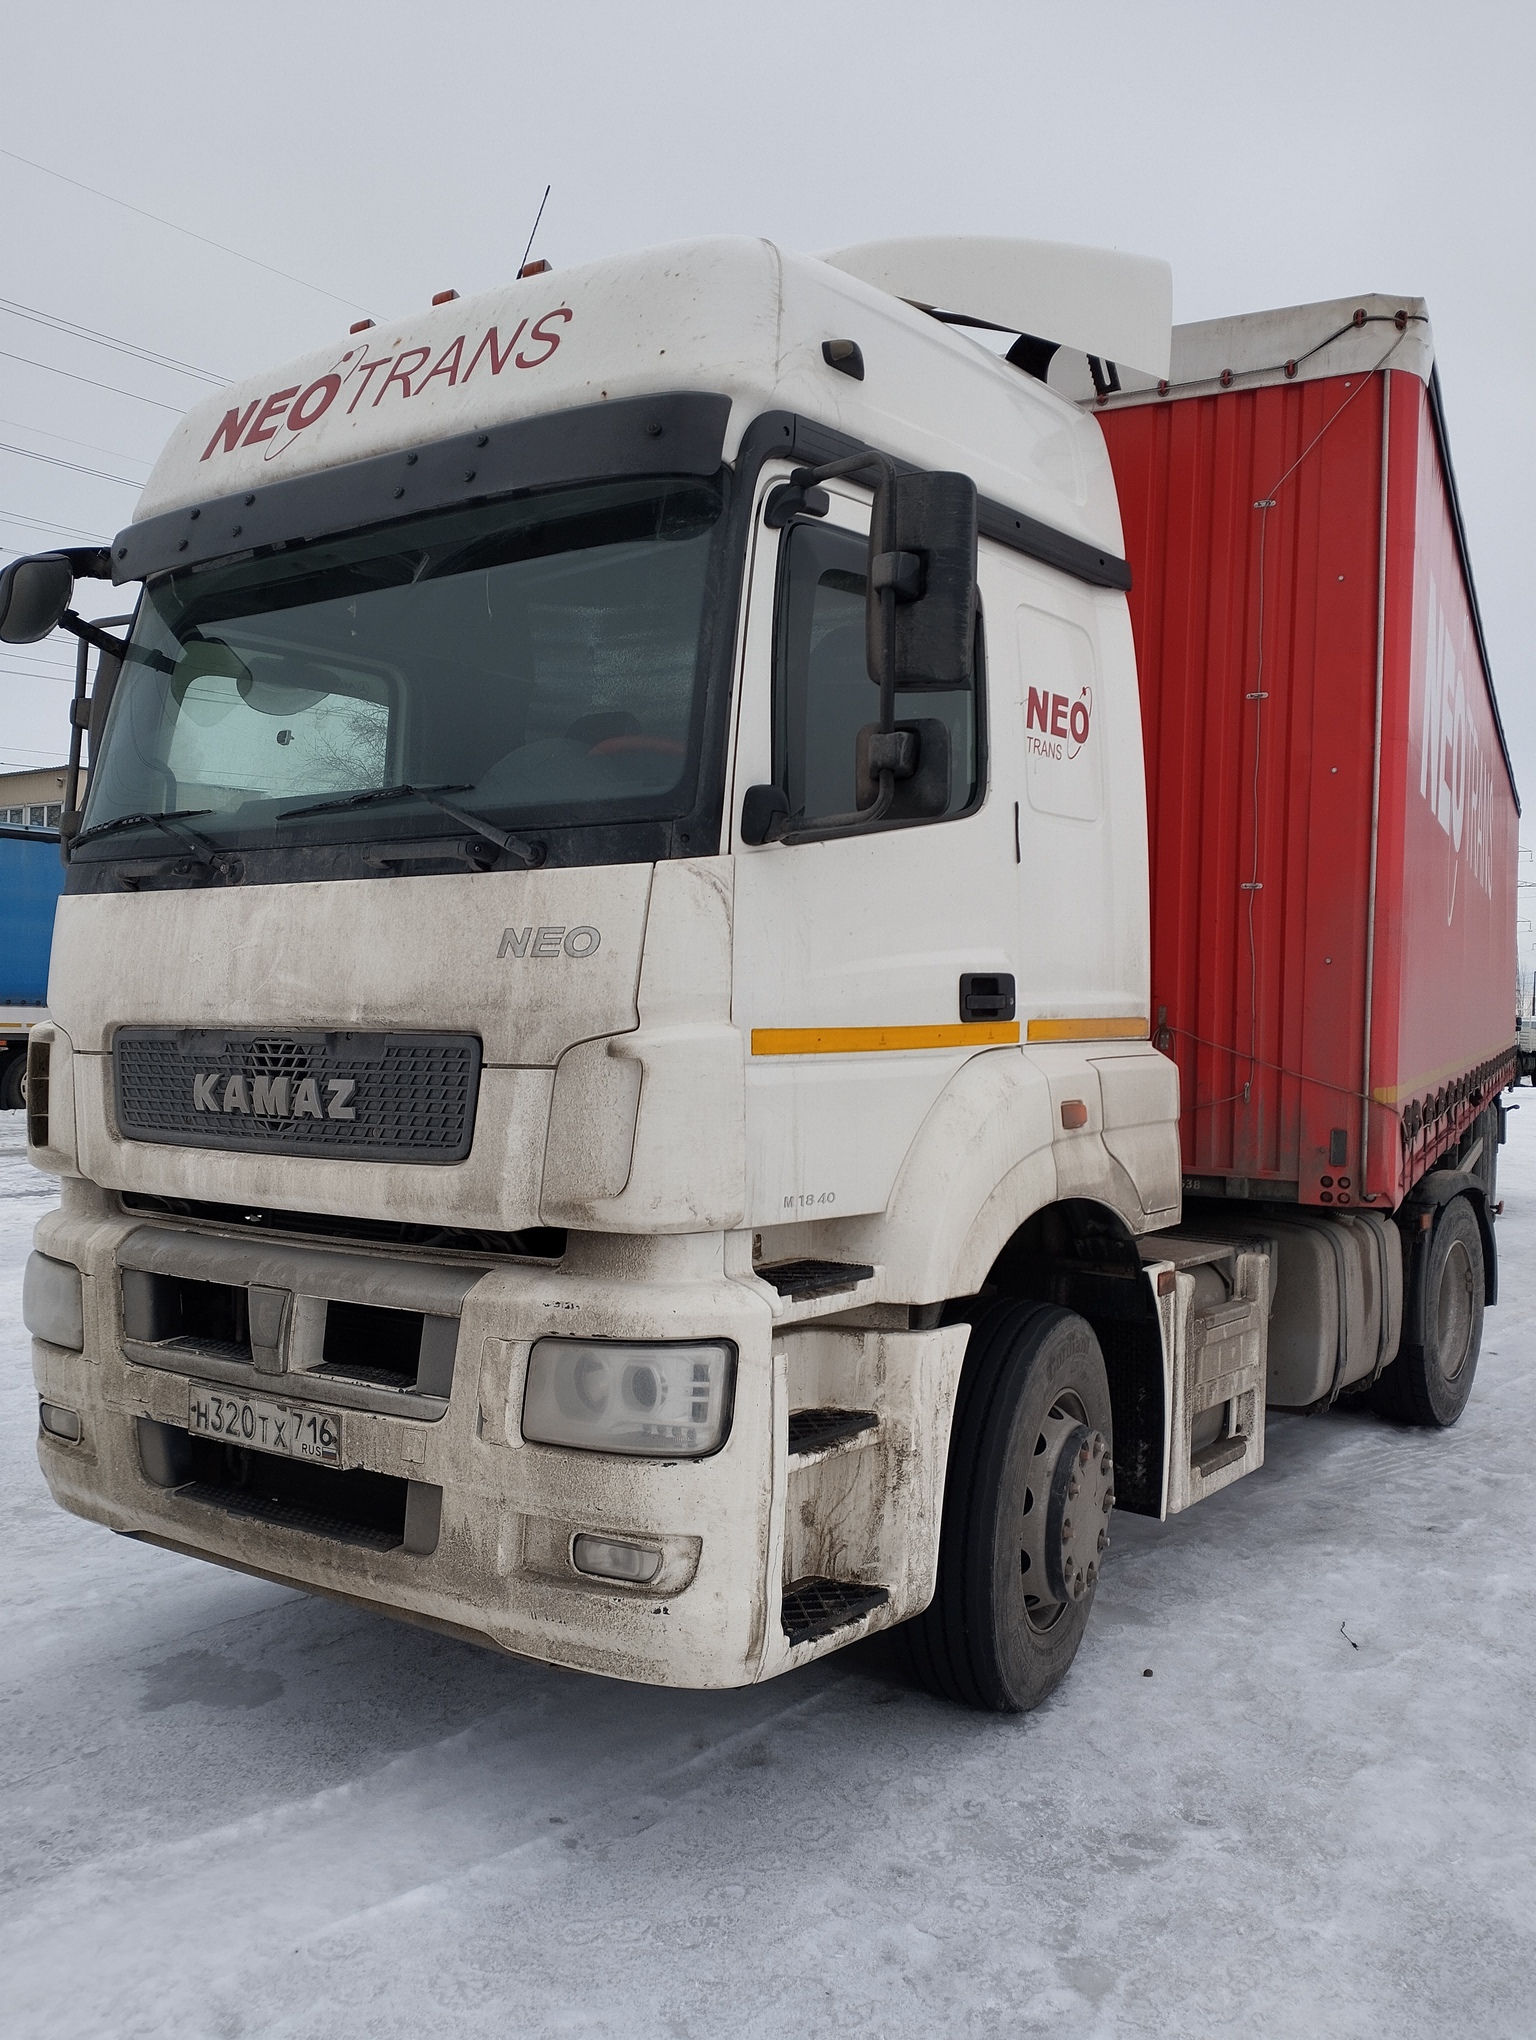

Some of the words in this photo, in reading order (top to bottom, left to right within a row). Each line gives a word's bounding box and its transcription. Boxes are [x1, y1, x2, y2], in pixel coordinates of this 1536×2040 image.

[200, 373, 342, 462] NEO
[346, 308, 573, 415] TRANS
[1026, 685, 1090, 744] NEO
[1420, 569, 1466, 853] NEO
[1026, 736, 1062, 761] TRANS
[496, 925, 602, 959] NEO
[193, 1073, 358, 1120] KAMAZ
[301, 1443, 322, 1458] RUS
